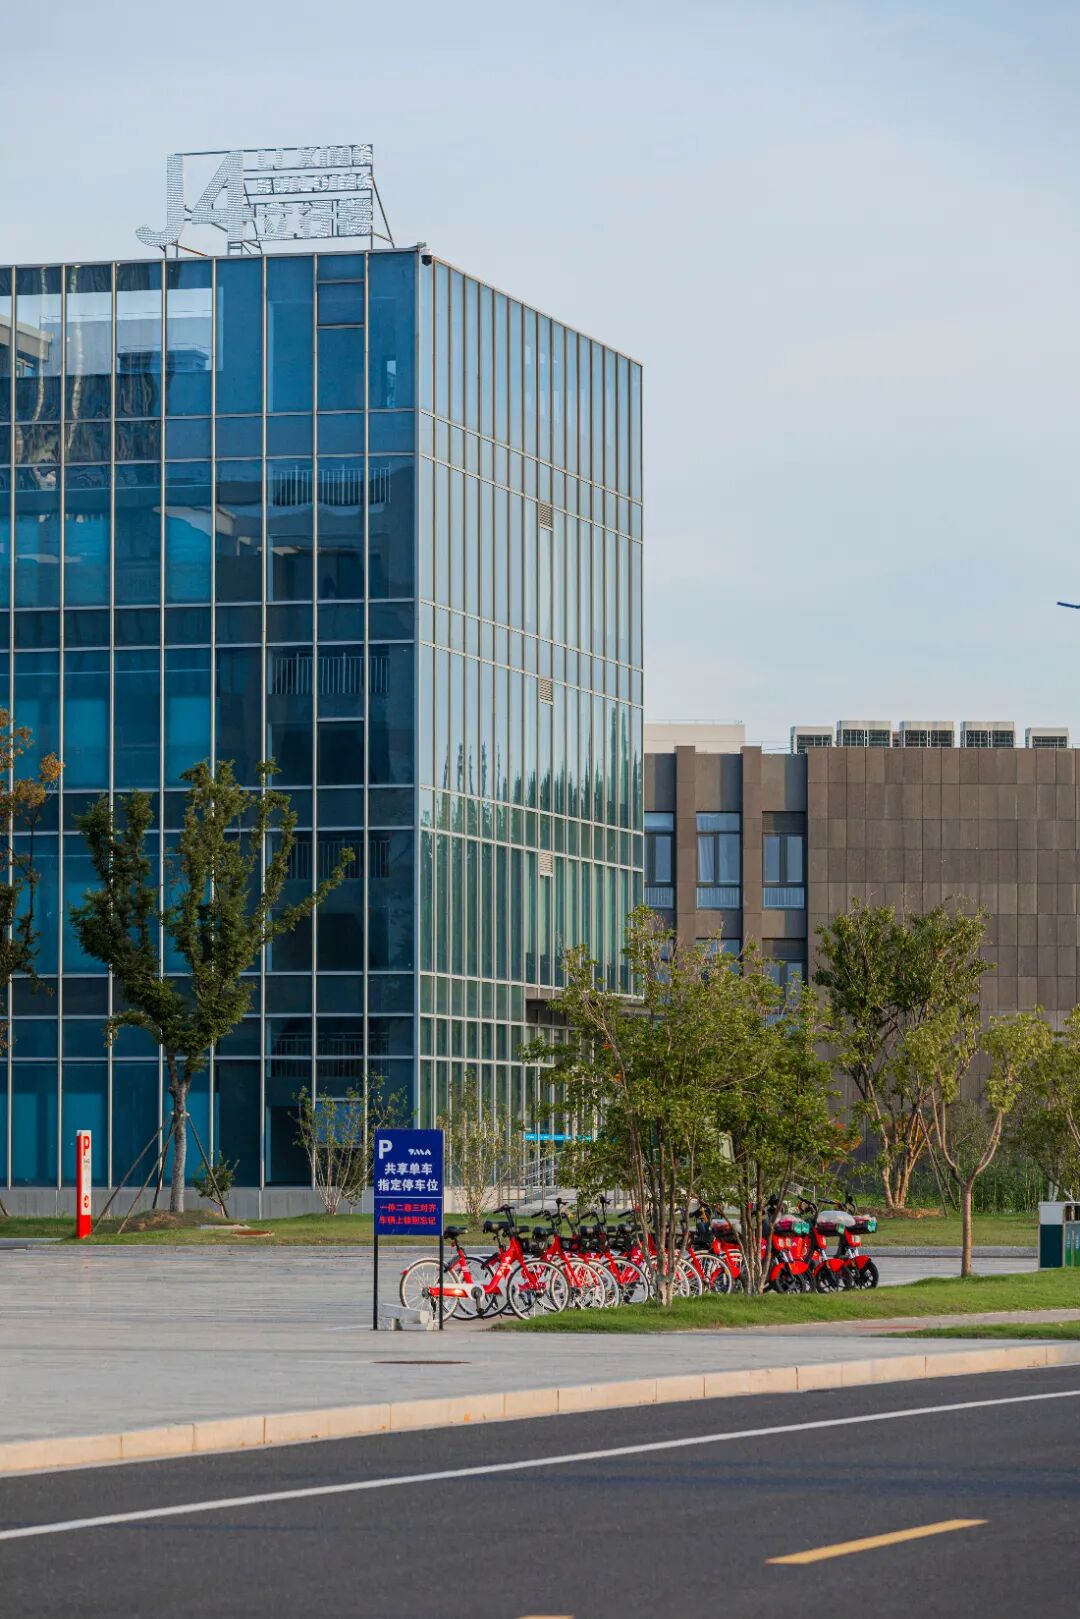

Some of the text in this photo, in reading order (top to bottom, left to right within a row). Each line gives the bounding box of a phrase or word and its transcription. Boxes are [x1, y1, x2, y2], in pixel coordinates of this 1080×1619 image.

[378, 1139, 393, 1159] P
[384, 1162, 433, 1176] 共享单车
[377, 1178, 439, 1192] 指定停车位
